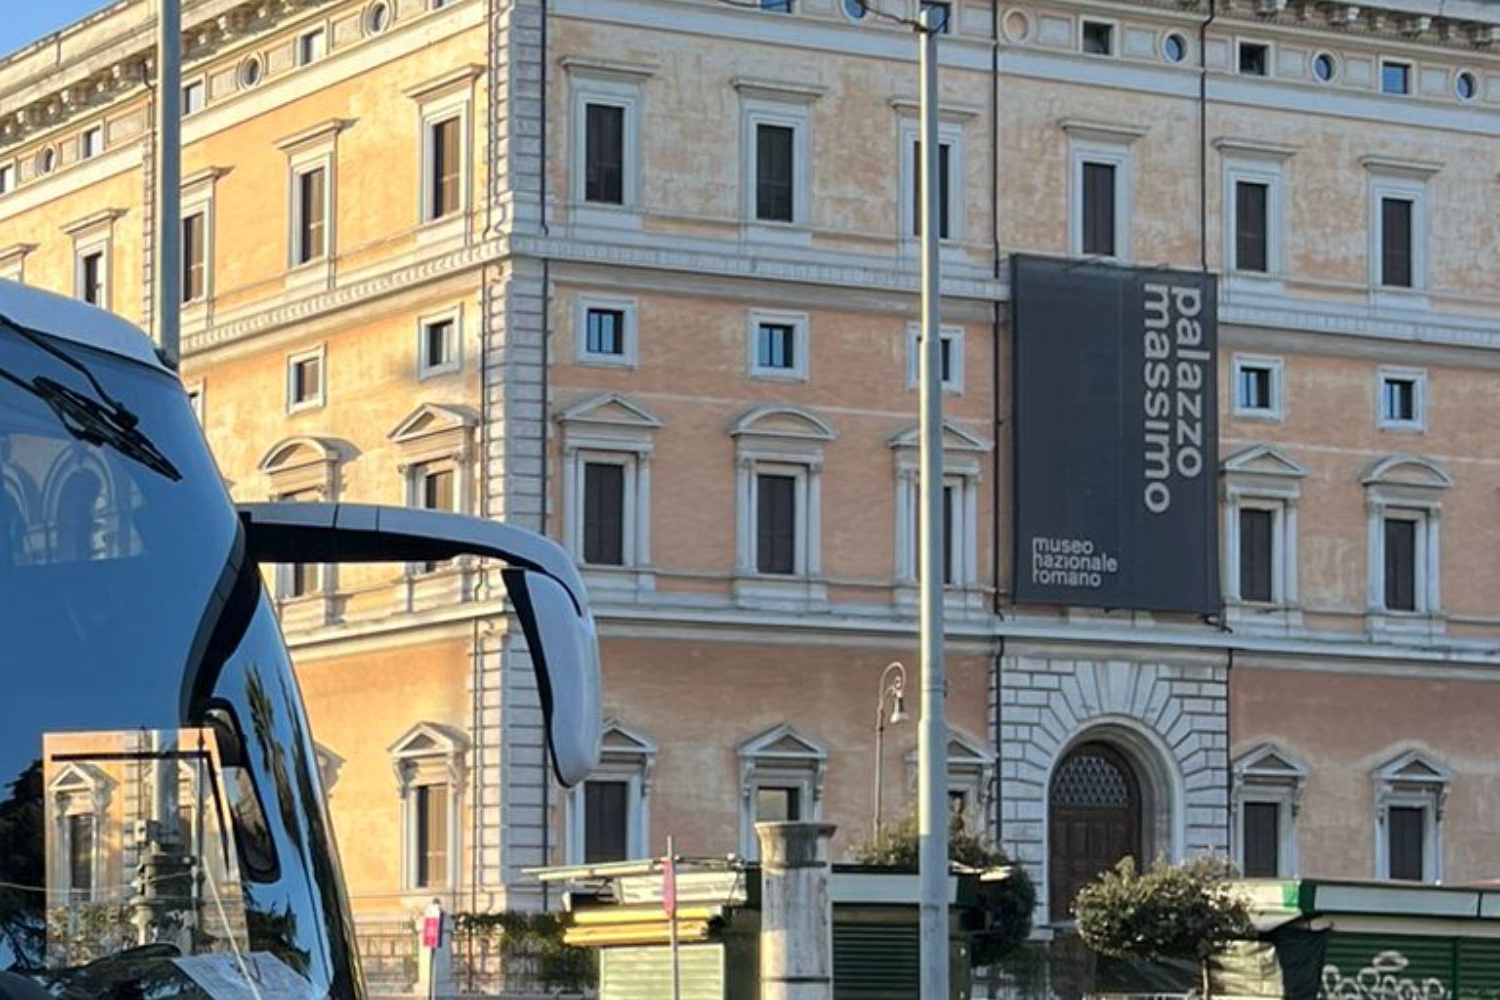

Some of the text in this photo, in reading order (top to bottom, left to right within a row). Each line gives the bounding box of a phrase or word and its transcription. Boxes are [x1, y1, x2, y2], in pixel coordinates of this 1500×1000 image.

[1171, 285, 1211, 478] palazzo
[1144, 283, 1171, 513] massimo
[1032, 537, 1095, 555] museo
[1032, 552, 1118, 573] nazionale
[1032, 568, 1102, 587] romano
